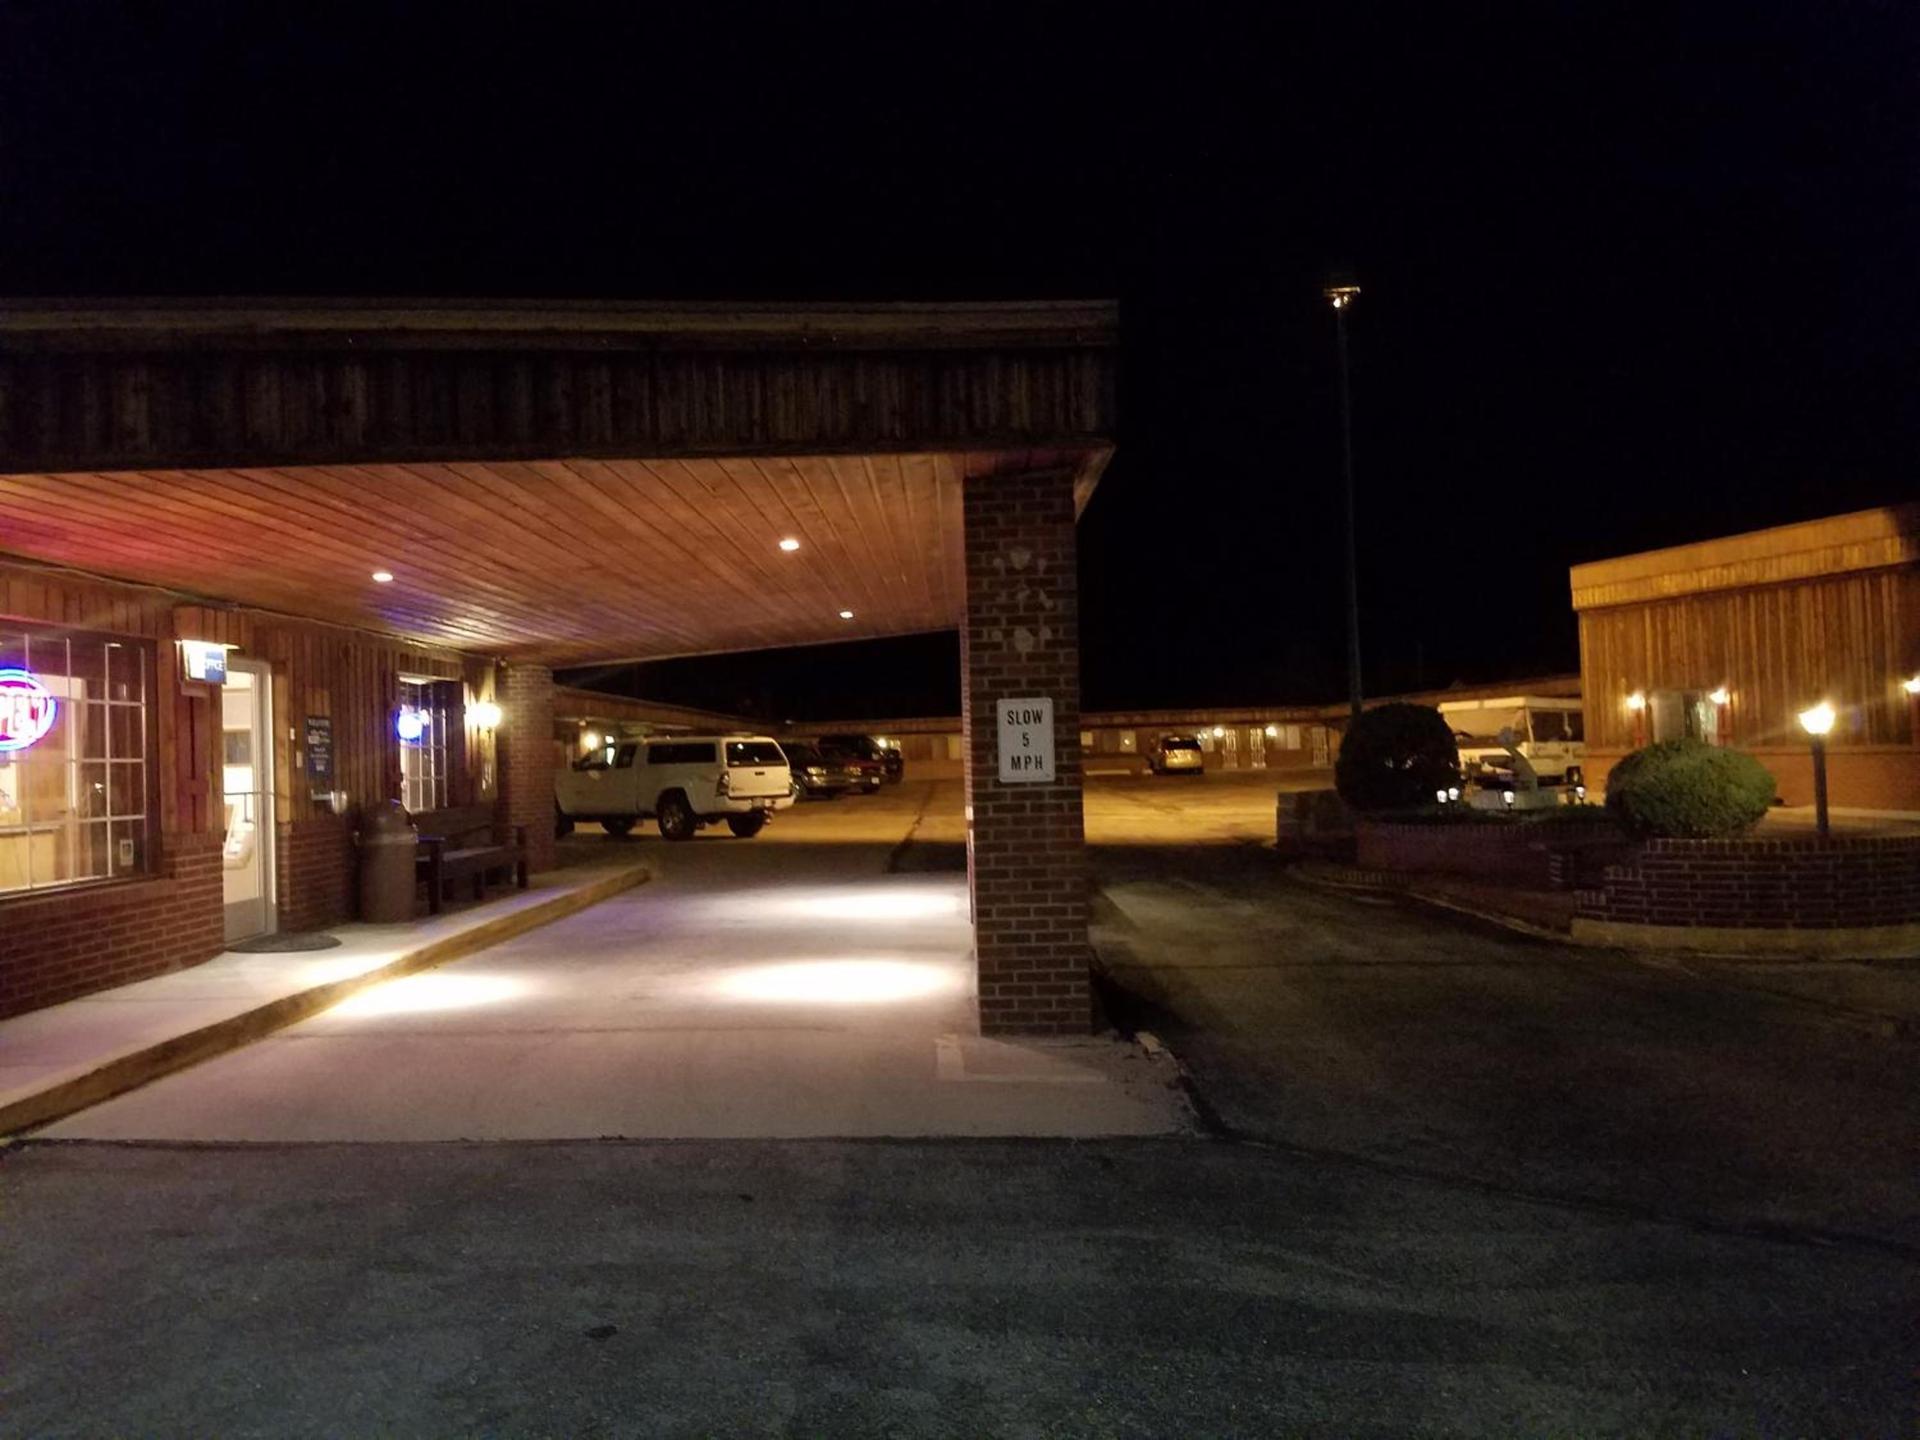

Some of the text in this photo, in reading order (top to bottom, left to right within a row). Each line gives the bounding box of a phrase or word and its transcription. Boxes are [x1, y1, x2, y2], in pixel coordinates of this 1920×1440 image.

[1007, 709, 1043, 725] SLOW
[1022, 732, 1030, 747] 5
[1011, 755, 1043, 770] MPH
